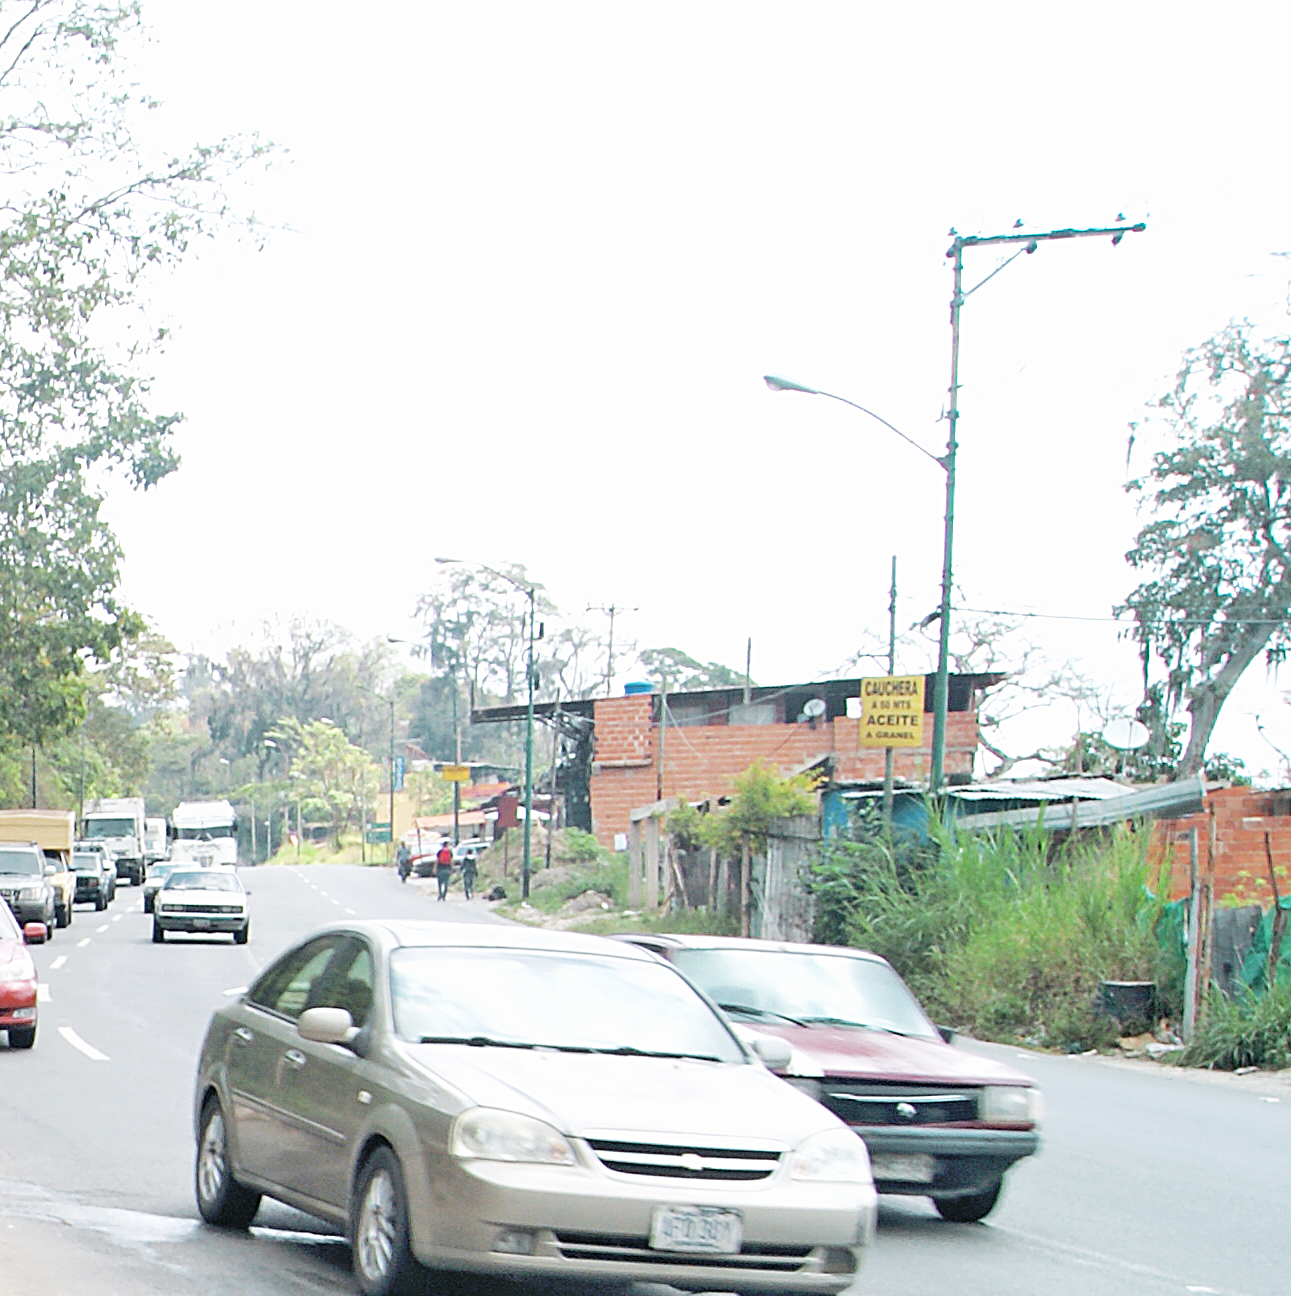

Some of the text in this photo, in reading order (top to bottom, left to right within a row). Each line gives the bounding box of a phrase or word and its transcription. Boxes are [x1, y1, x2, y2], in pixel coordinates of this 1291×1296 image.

[865, 681, 918, 696] CAUCHERA
[867, 715, 918, 726] ACEITE
[875, 731, 914, 739] GRANEL
